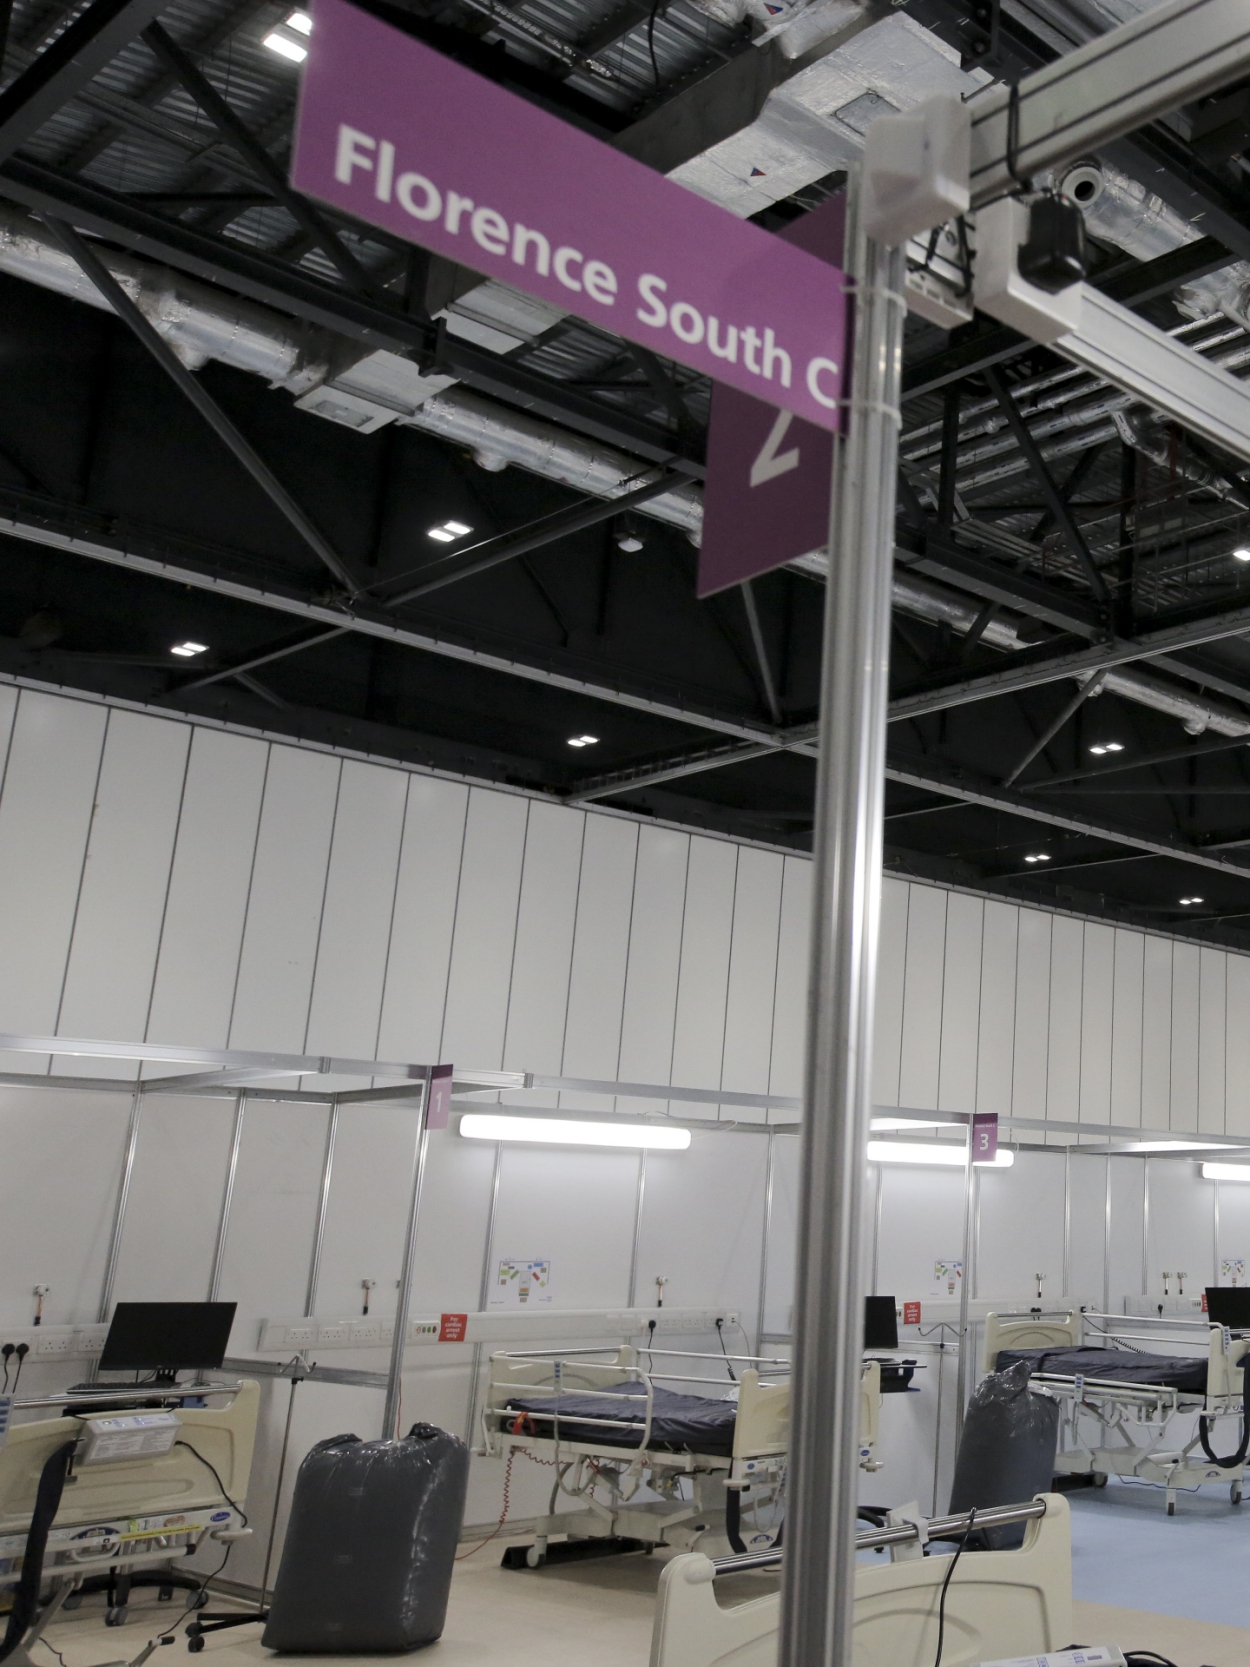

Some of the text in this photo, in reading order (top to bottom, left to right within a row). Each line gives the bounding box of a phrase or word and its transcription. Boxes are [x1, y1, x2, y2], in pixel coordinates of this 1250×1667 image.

[334, 122, 839, 410] Florence South C
[436, 1091, 442, 1113] 1
[980, 1133, 989, 1150] 3
